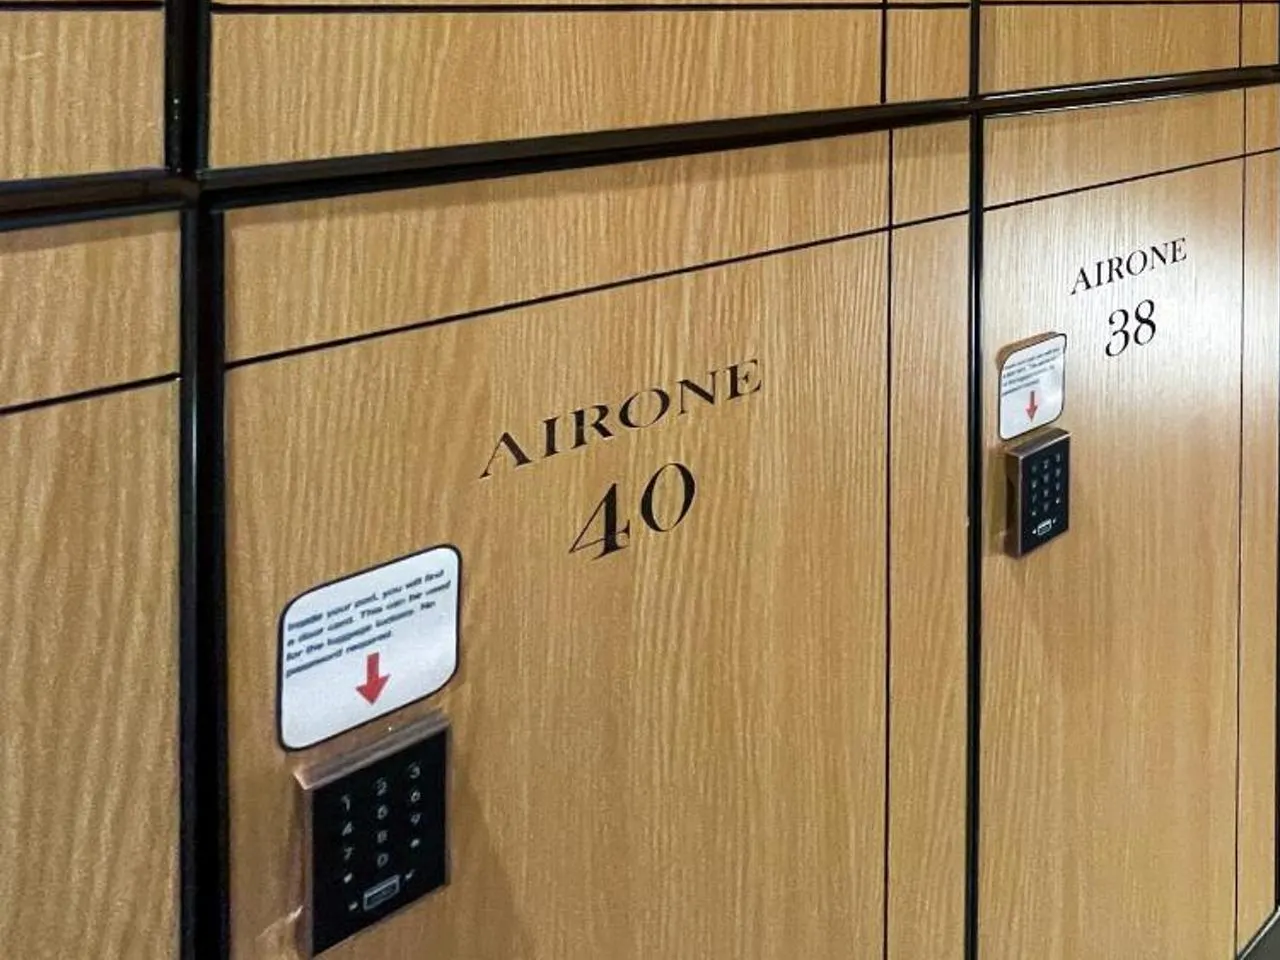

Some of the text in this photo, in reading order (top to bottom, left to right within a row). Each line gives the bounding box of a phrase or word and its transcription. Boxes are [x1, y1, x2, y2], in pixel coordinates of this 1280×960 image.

[1070, 237, 1188, 295] AIRONE
[1105, 298, 1157, 358] 38
[478, 359, 763, 479] AIRONE
[568, 462, 696, 561] 40
